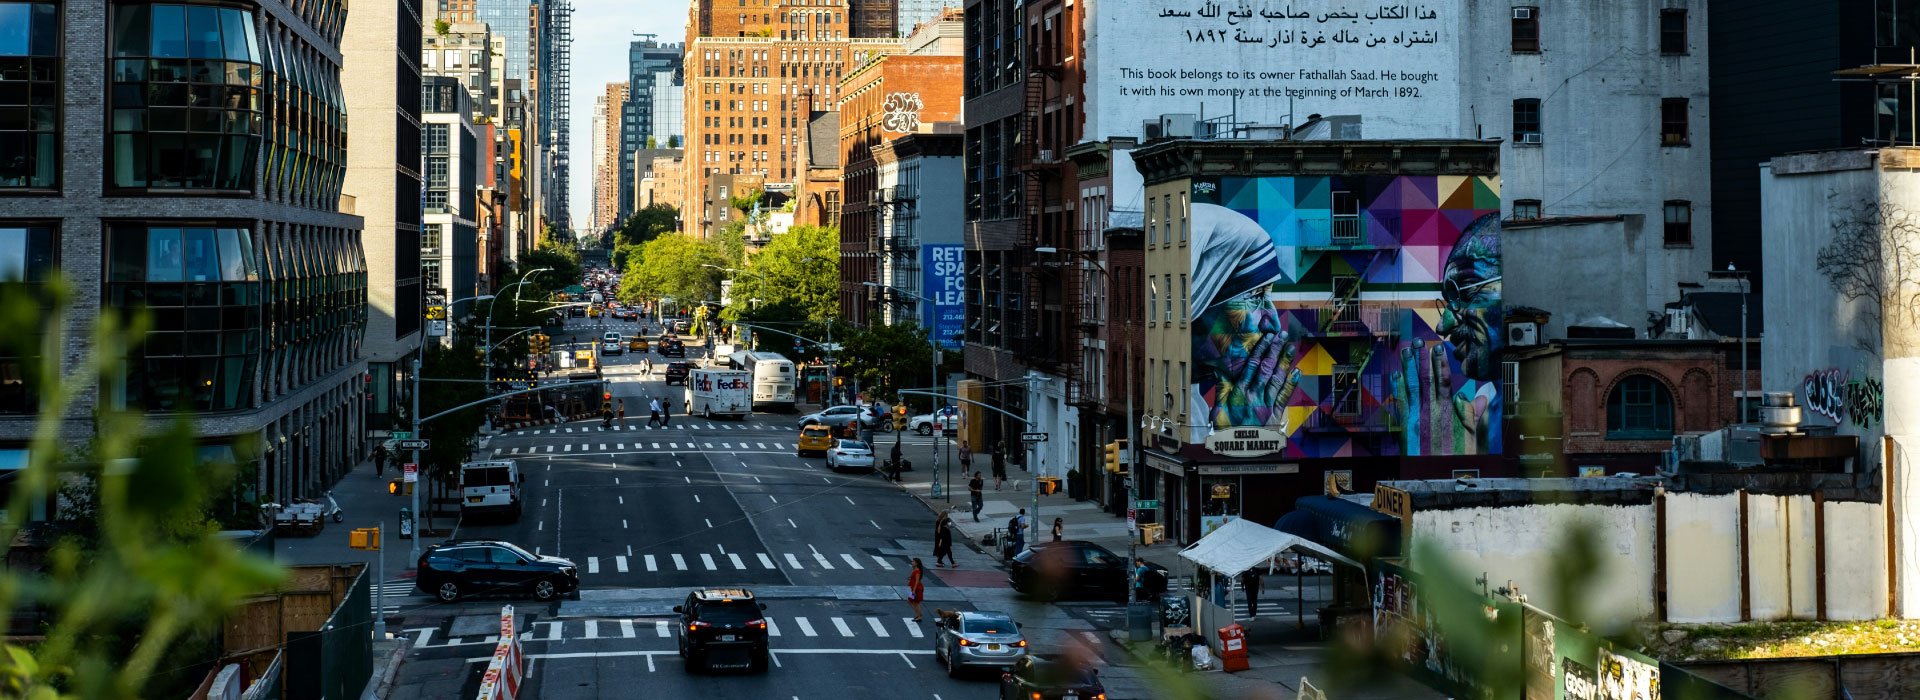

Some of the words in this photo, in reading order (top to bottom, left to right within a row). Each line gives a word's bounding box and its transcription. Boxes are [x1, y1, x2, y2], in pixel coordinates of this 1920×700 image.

[1158, 7, 1191, 18] سعد
[1227, 4, 1253, 25] فتح
[1259, 4, 1310, 23] صاحبه
[1316, 5, 1358, 23] يخص
[1365, 4, 1409, 25] الكتاب
[1414, 4, 1437, 20] هذا
[1186, 29, 1227, 43] ١٨٩٢
[1234, 28, 1263, 44] سنة
[1268, 29, 1294, 48] اذار
[1300, 30, 1326, 48] غرة
[1365, 33, 1386, 48] من
[1393, 29, 1438, 48] اشتراه
[1119, 68, 1144, 79] This
[1147, 68, 1177, 79] book
[1180, 68, 1223, 82] belongs
[1227, 71, 1239, 80] to
[1243, 69, 1256, 80] its
[1299, 69, 1347, 81] Fathallah
[1350, 69, 1378, 81] Saad.
[1380, 70, 1397, 81] He
[1401, 70, 1439, 84] bought
[1119, 85, 1128, 96] it
[1131, 85, 1156, 96] with
[1160, 85, 1176, 97] his
[1179, 89, 1203, 97] own
[1207, 89, 1245, 100] money
[1248, 87, 1260, 97] at
[1263, 86, 1282, 97] the
[1285, 87, 1337, 100] beginning
[1340, 87, 1351, 98] of
[1355, 87, 1389, 98] March
[1394, 87, 1422, 98] 1892.
[695, 373, 713, 392] FedEx
[717, 378, 749, 390] FedEx
[1234, 430, 1259, 439] CHELSEA
[1214, 441, 1245, 451] SQUARE
[1246, 440, 1280, 450] MARKET
[1377, 488, 1403, 515] DINER
